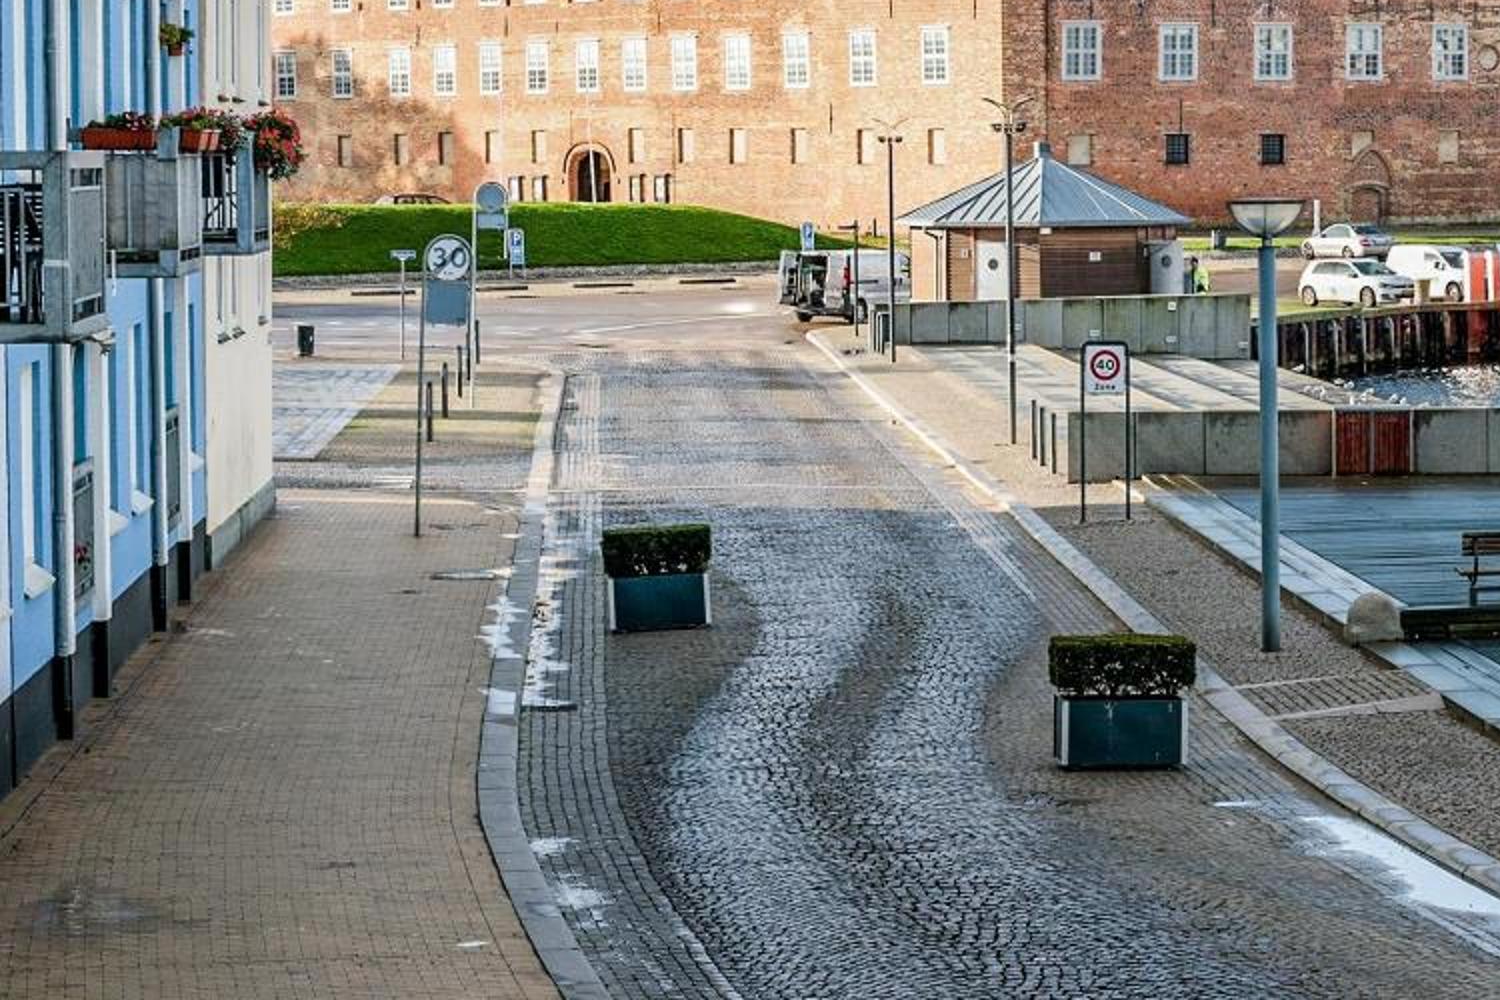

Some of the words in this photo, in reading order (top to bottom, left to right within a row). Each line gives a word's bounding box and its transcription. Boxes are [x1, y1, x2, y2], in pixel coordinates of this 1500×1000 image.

[513, 232, 521, 246] P
[432, 247, 467, 268] 30
[1095, 359, 1115, 371] 40
